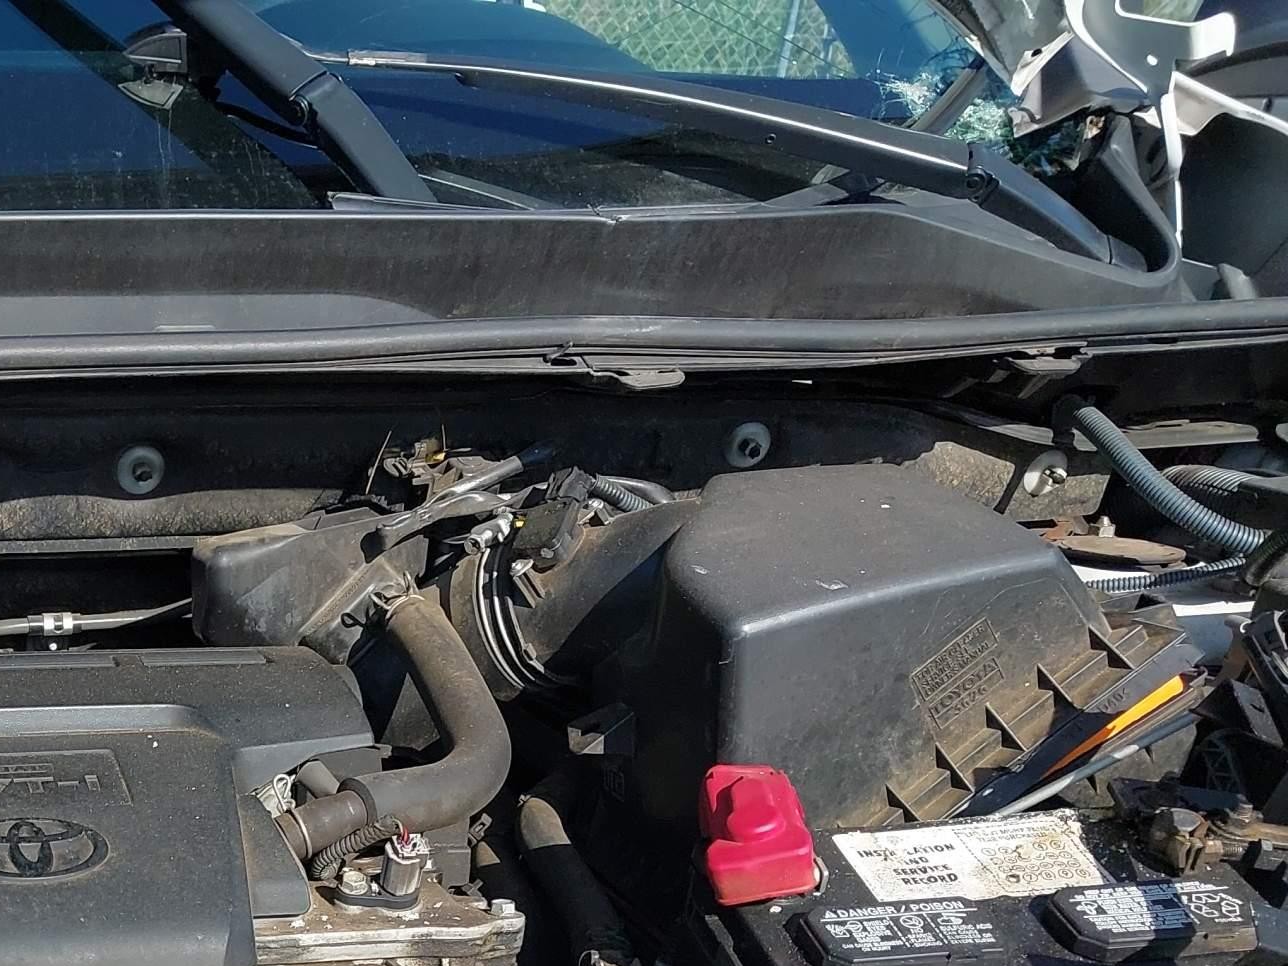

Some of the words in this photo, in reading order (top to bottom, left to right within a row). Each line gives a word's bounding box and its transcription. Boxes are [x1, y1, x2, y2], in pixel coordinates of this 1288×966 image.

[930, 662, 998, 715] TOYOTA
[857, 843, 955, 858] INSTALATION
[893, 864, 952, 876] SERVICE
[901, 873, 958, 885] RECORD
[836, 906, 897, 918] DANGER
[909, 901, 965, 912] POISON
